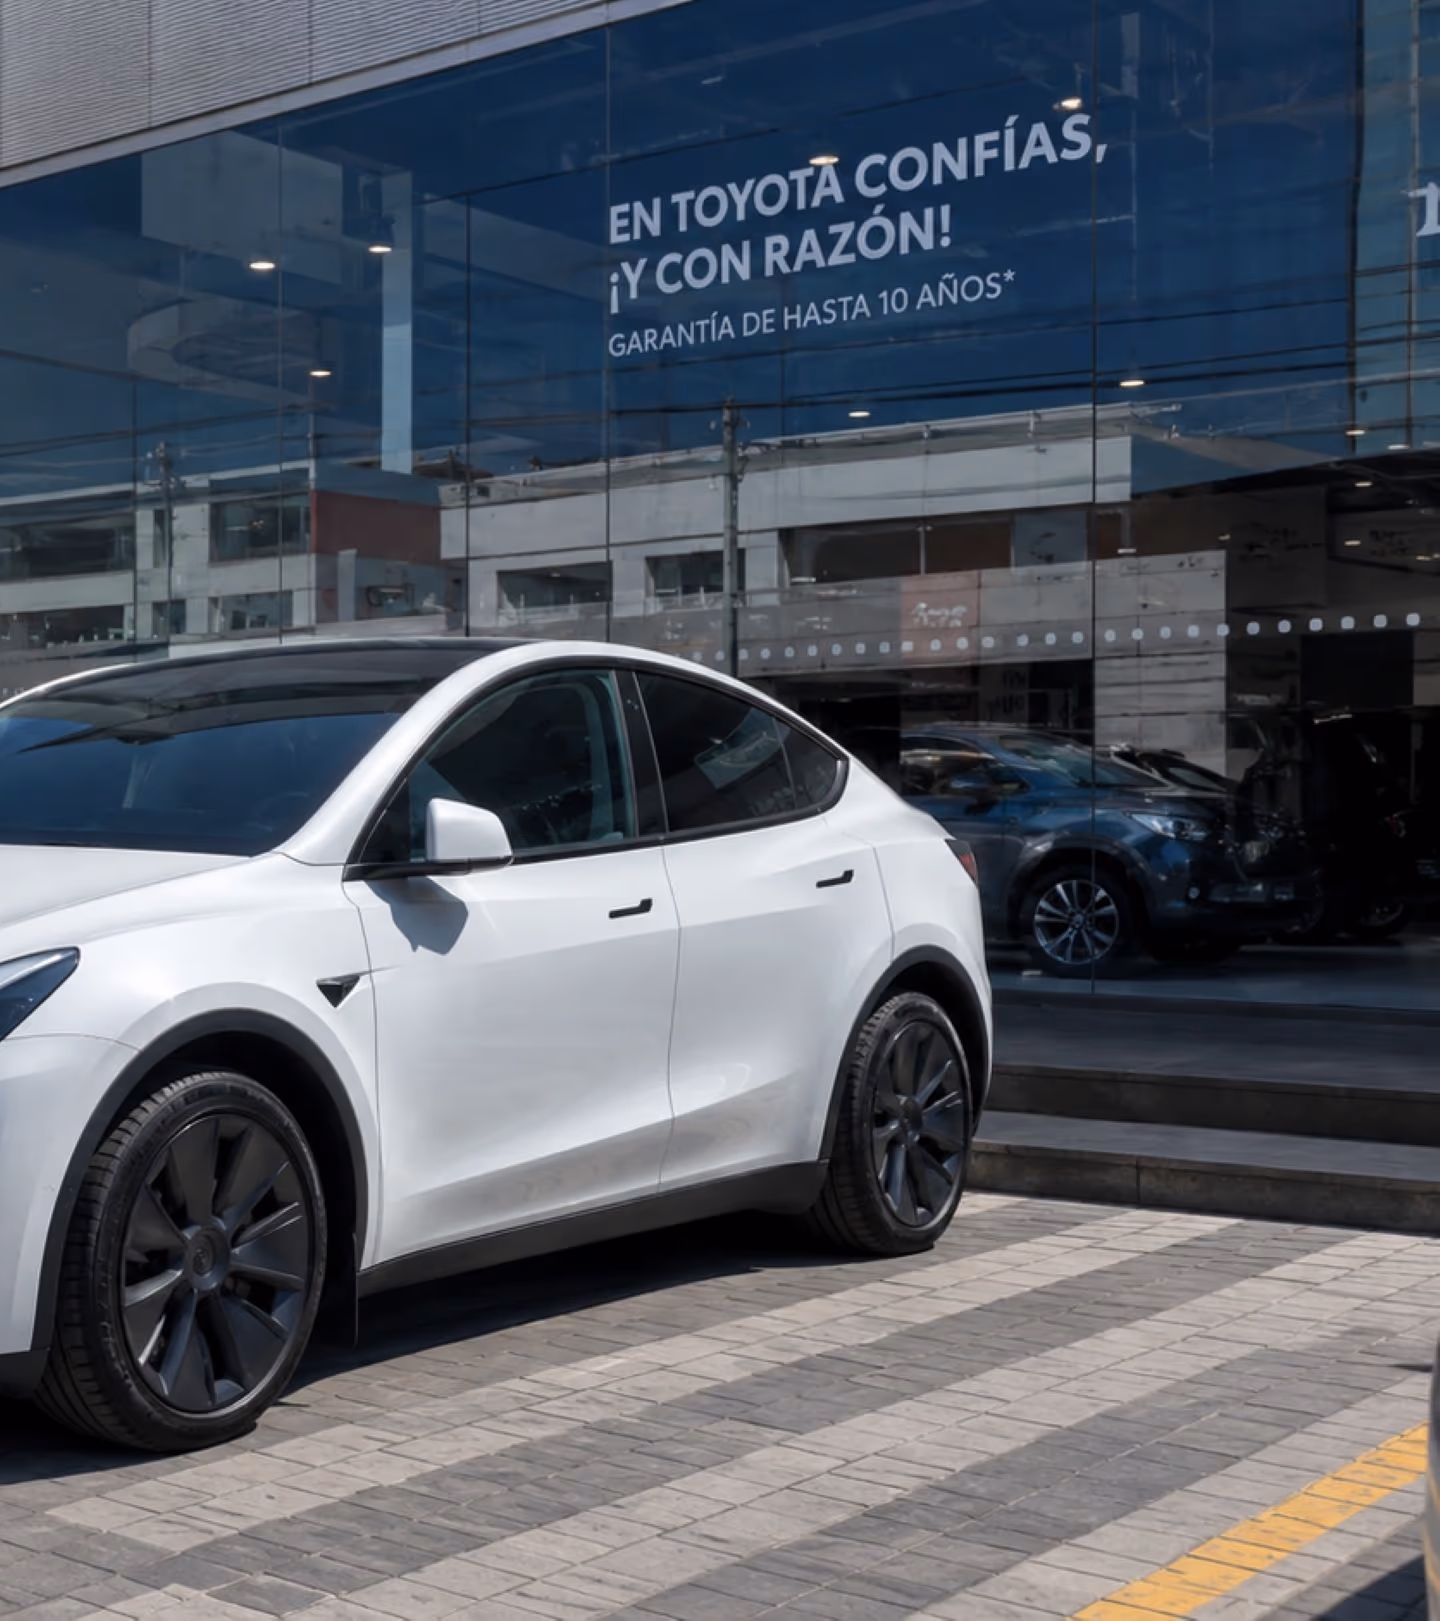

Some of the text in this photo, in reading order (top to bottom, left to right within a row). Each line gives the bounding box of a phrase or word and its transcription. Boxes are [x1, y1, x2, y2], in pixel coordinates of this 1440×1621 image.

[609, 113, 1108, 244] EN TOYOTA CONFÍAS,
[609, 204, 951, 314] ¡Y CON RAZÓN!
[609, 311, 735, 357] GARANTÍA
[743, 308, 775, 337] DE
[783, 292, 871, 330] HASTA
[878, 288, 908, 316] 10
